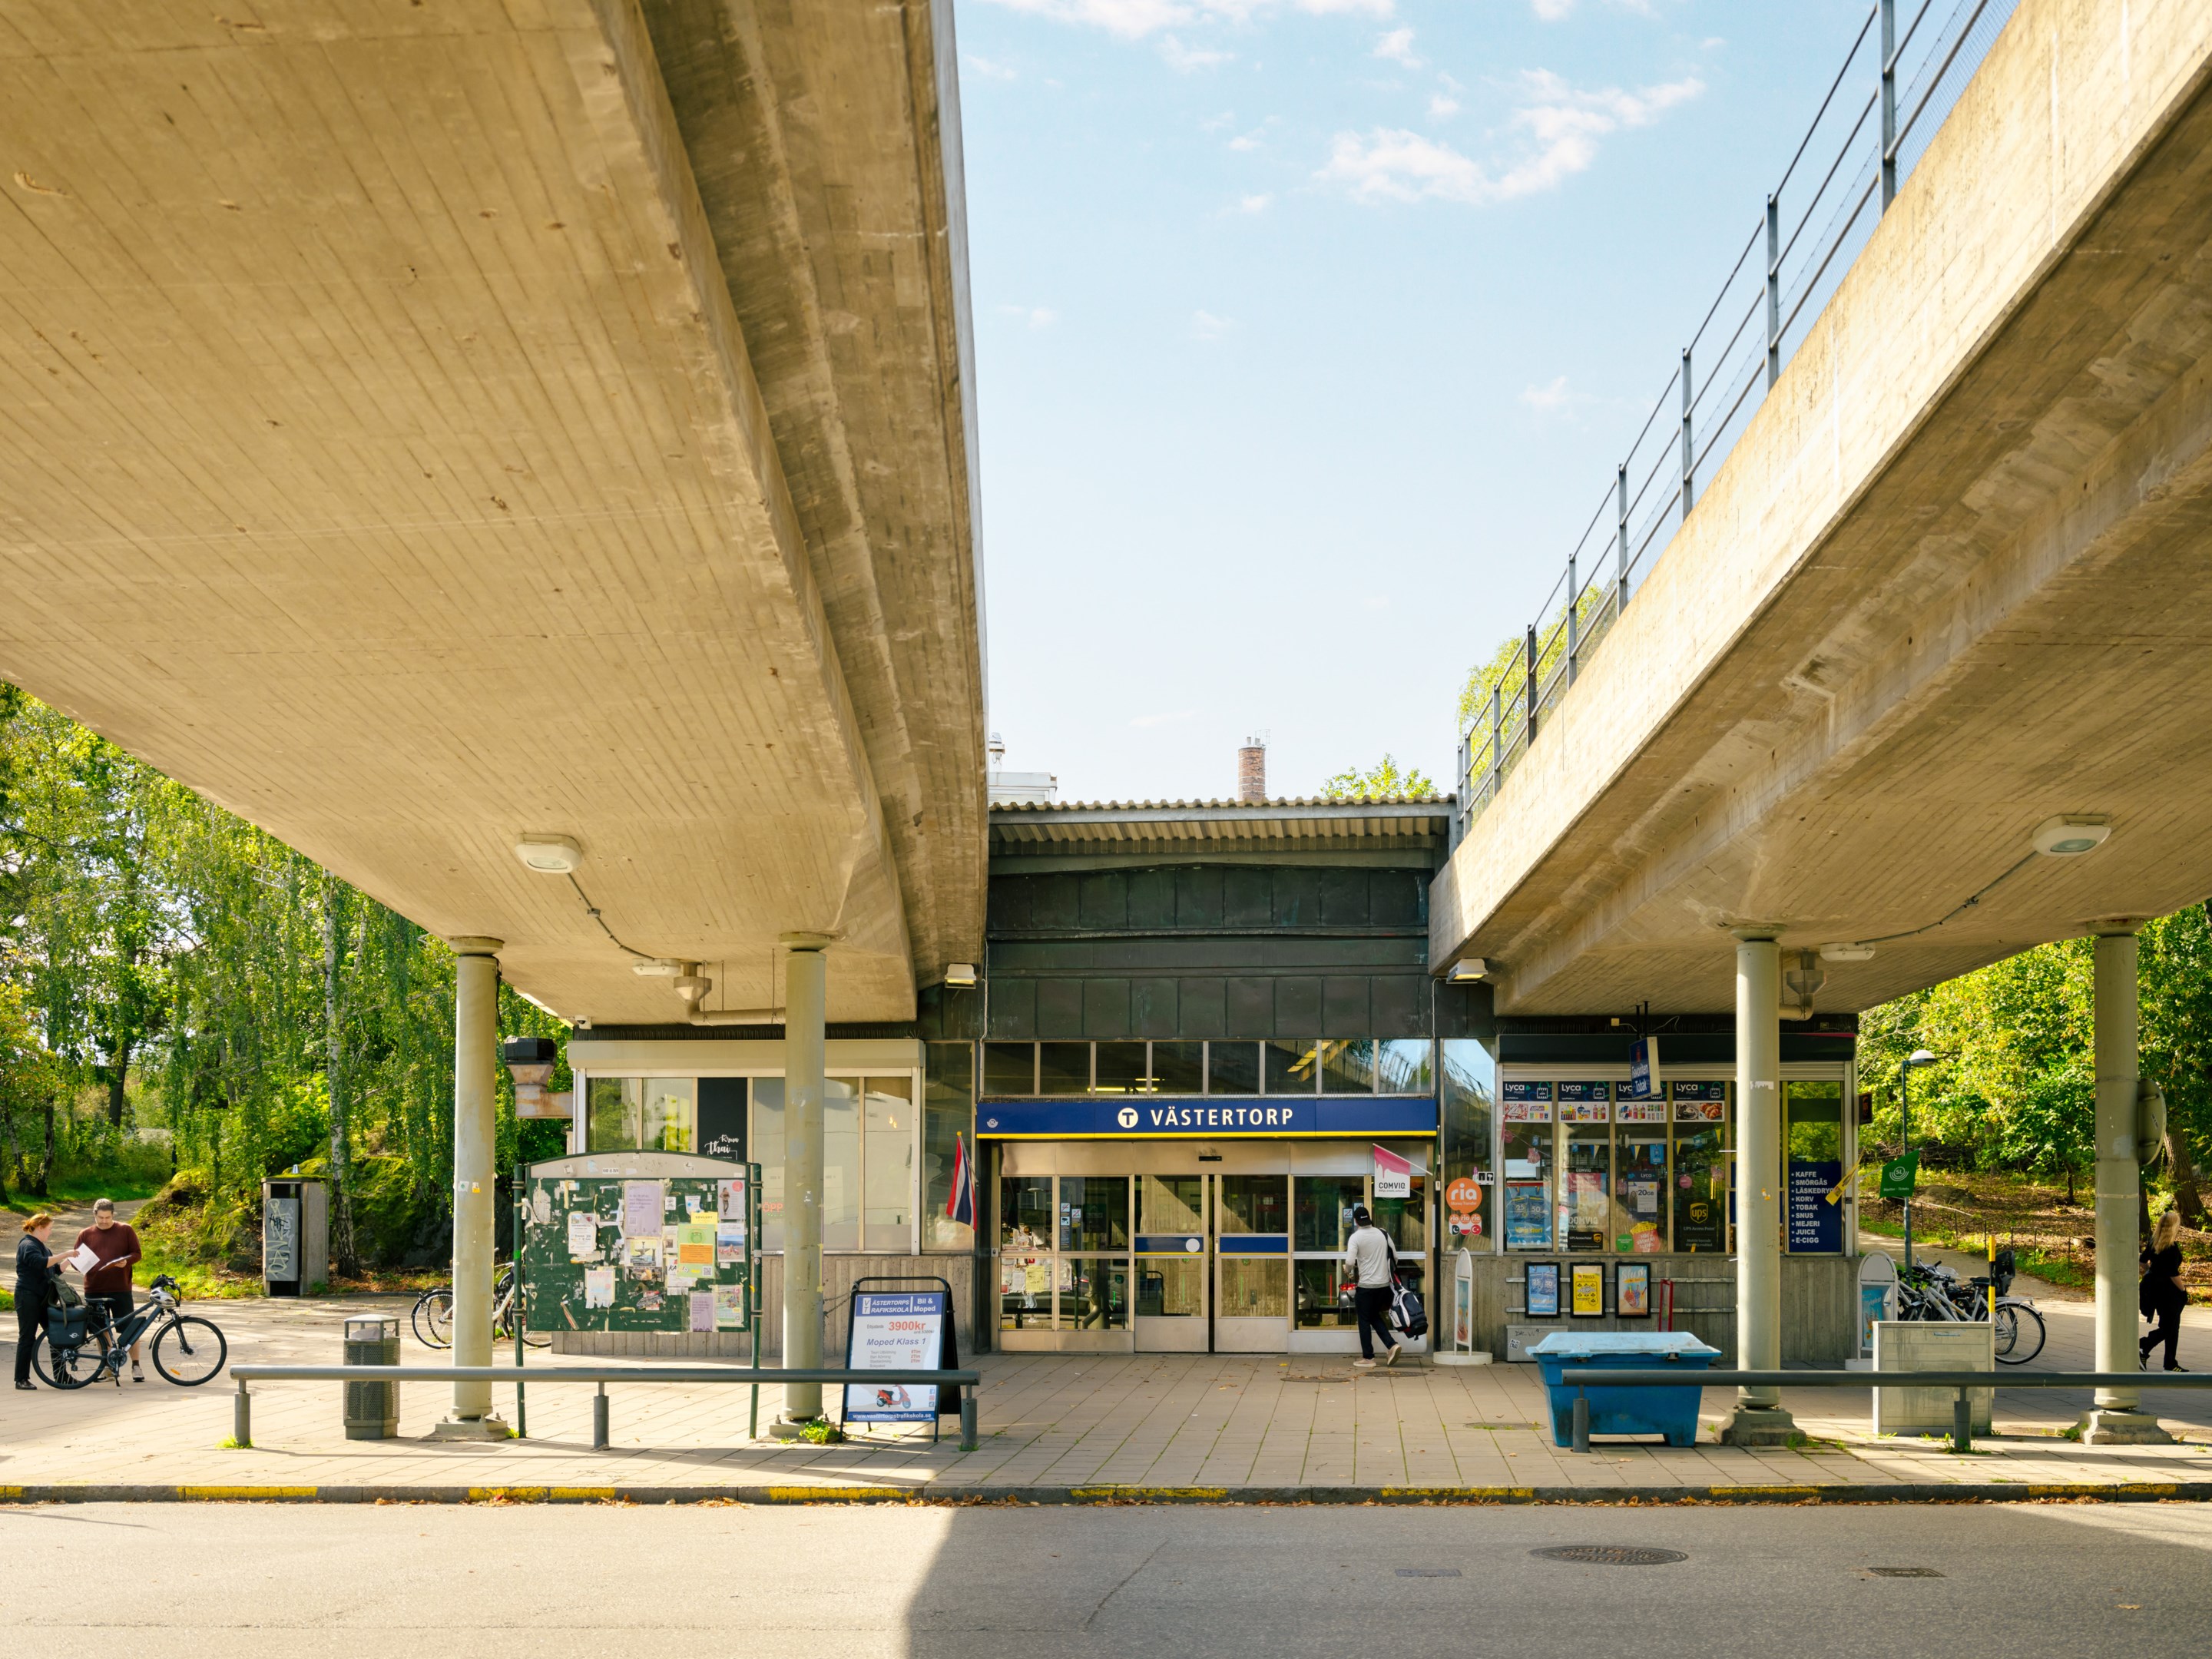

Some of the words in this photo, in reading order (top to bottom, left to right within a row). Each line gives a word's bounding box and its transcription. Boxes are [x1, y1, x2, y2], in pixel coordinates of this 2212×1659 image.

[1505, 1083, 1525, 1091] Lyca
[1561, 1084, 1581, 1092] Lyca
[1634, 1078, 1647, 1093] Tobak
[1676, 1082, 1698, 1091] Lyca
[1151, 1105, 1293, 1126] VÄSTERTORP
[1451, 1183, 1477, 1200] ria
[1692, 1209, 1707, 1220] ups
[889, 1321, 926, 1331] 3900kr
[866, 1338, 895, 1347] Moped
